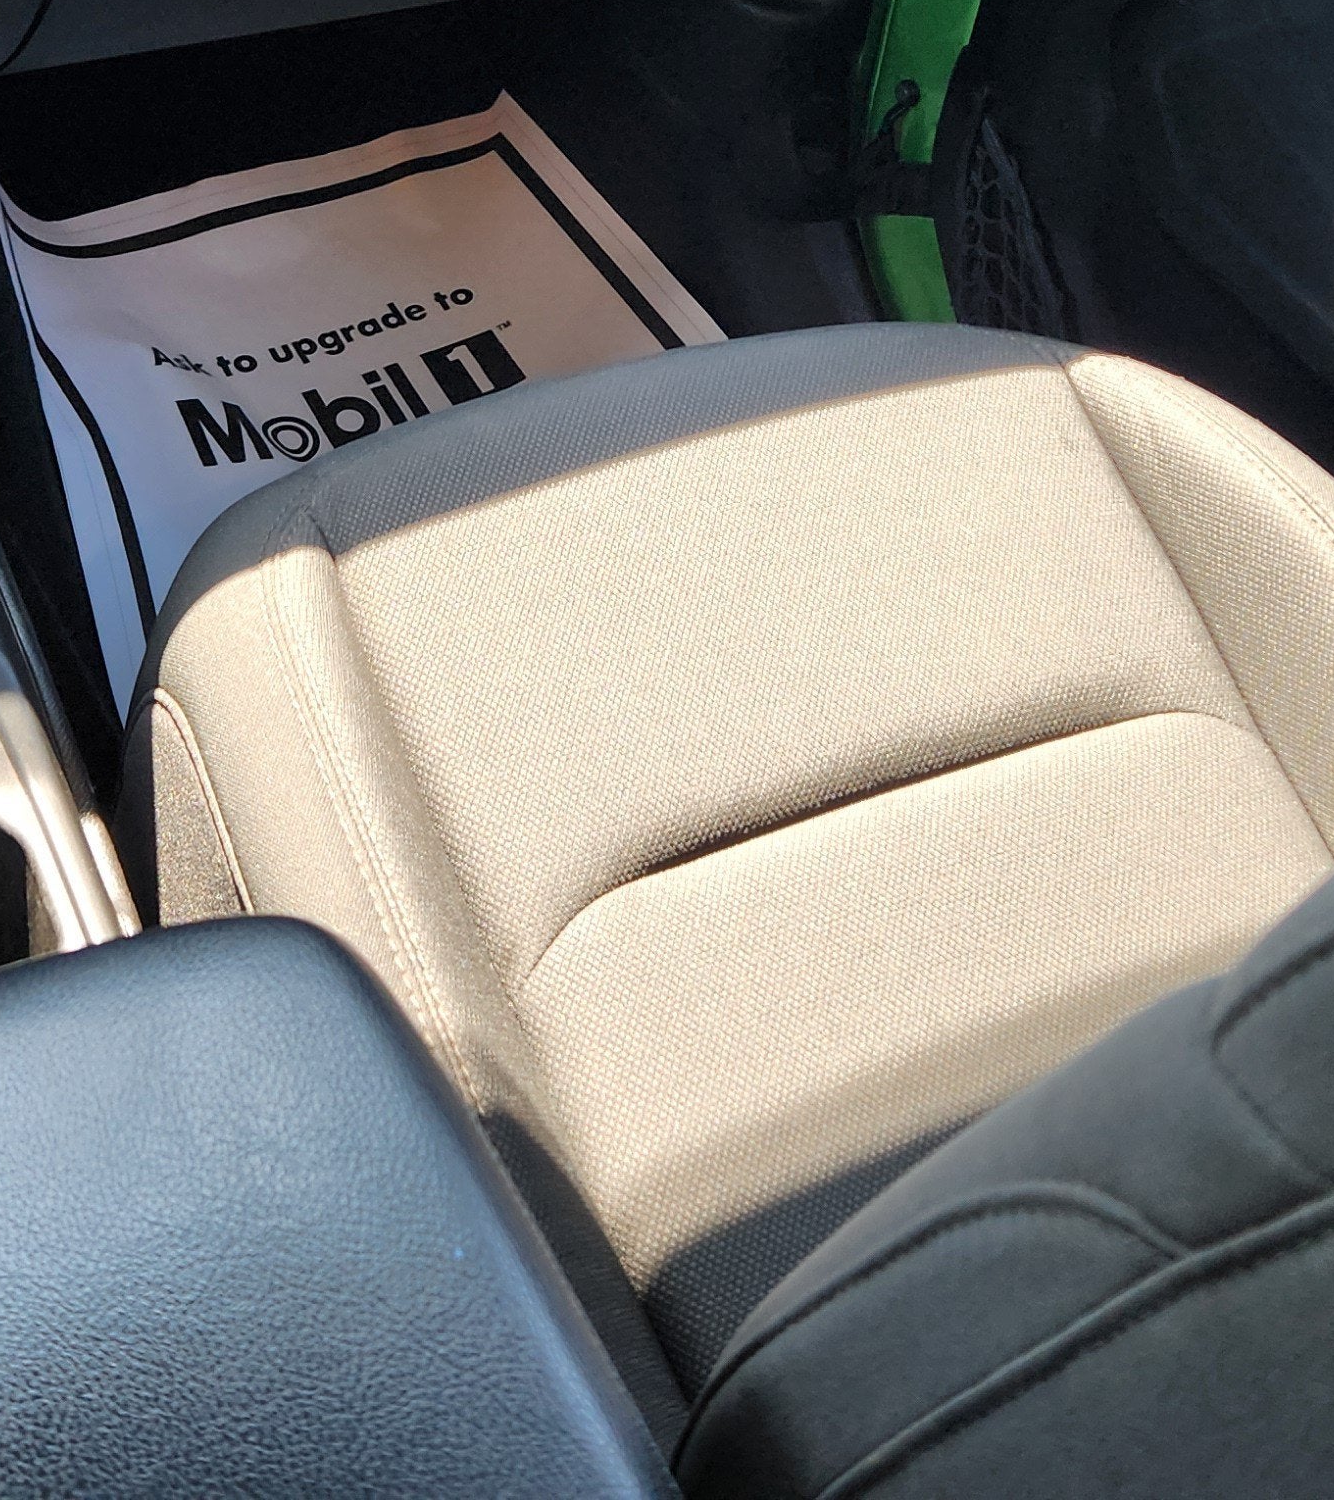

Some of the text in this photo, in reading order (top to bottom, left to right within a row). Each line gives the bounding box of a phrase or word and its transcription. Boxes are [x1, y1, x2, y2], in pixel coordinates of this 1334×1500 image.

[216, 354, 258, 377] to
[267, 301, 427, 365] upgrade
[433, 287, 474, 311] to
[175, 363, 430, 467] Mobil
